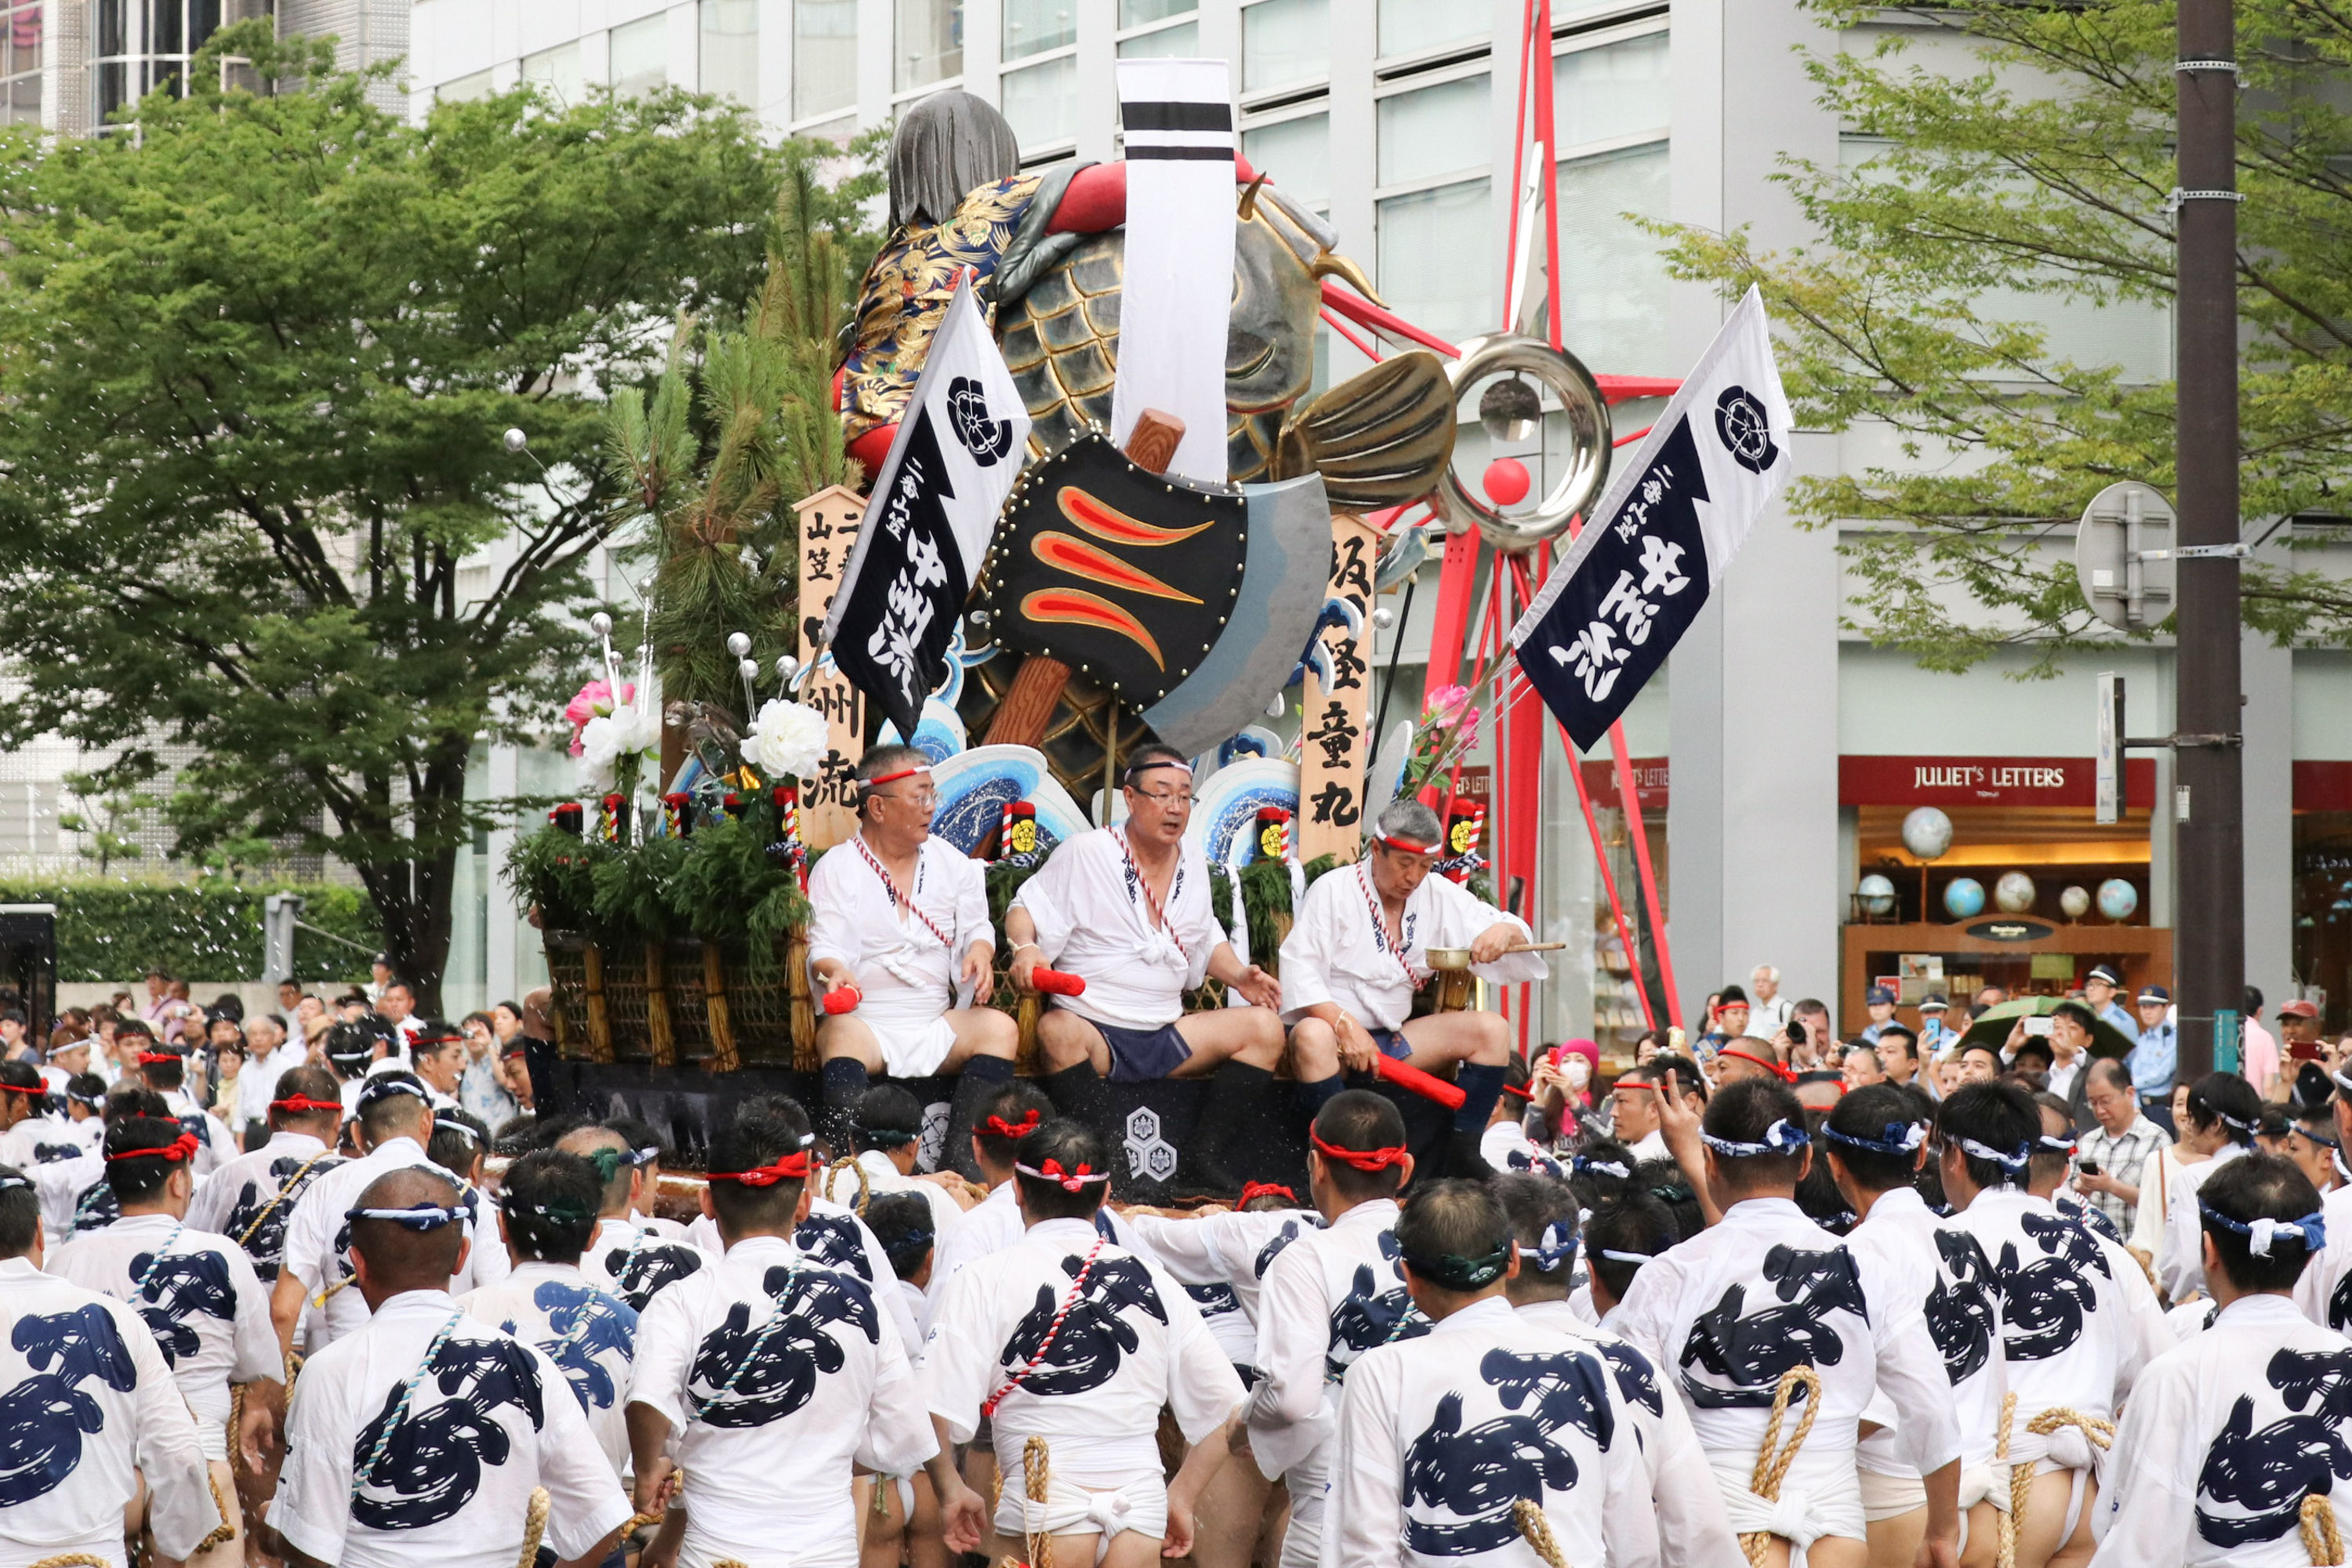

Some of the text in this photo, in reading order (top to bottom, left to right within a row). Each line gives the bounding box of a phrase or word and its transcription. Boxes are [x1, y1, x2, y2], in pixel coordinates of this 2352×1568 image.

[886, 457, 924, 543] 二番山笠
[806, 511, 833, 582] 山笠
[868, 528, 948, 707] 中洲流
[1306, 535, 1372, 827] 坂怪童丸
[1915, 766, 2064, 788] JULIET'S LETTERS
